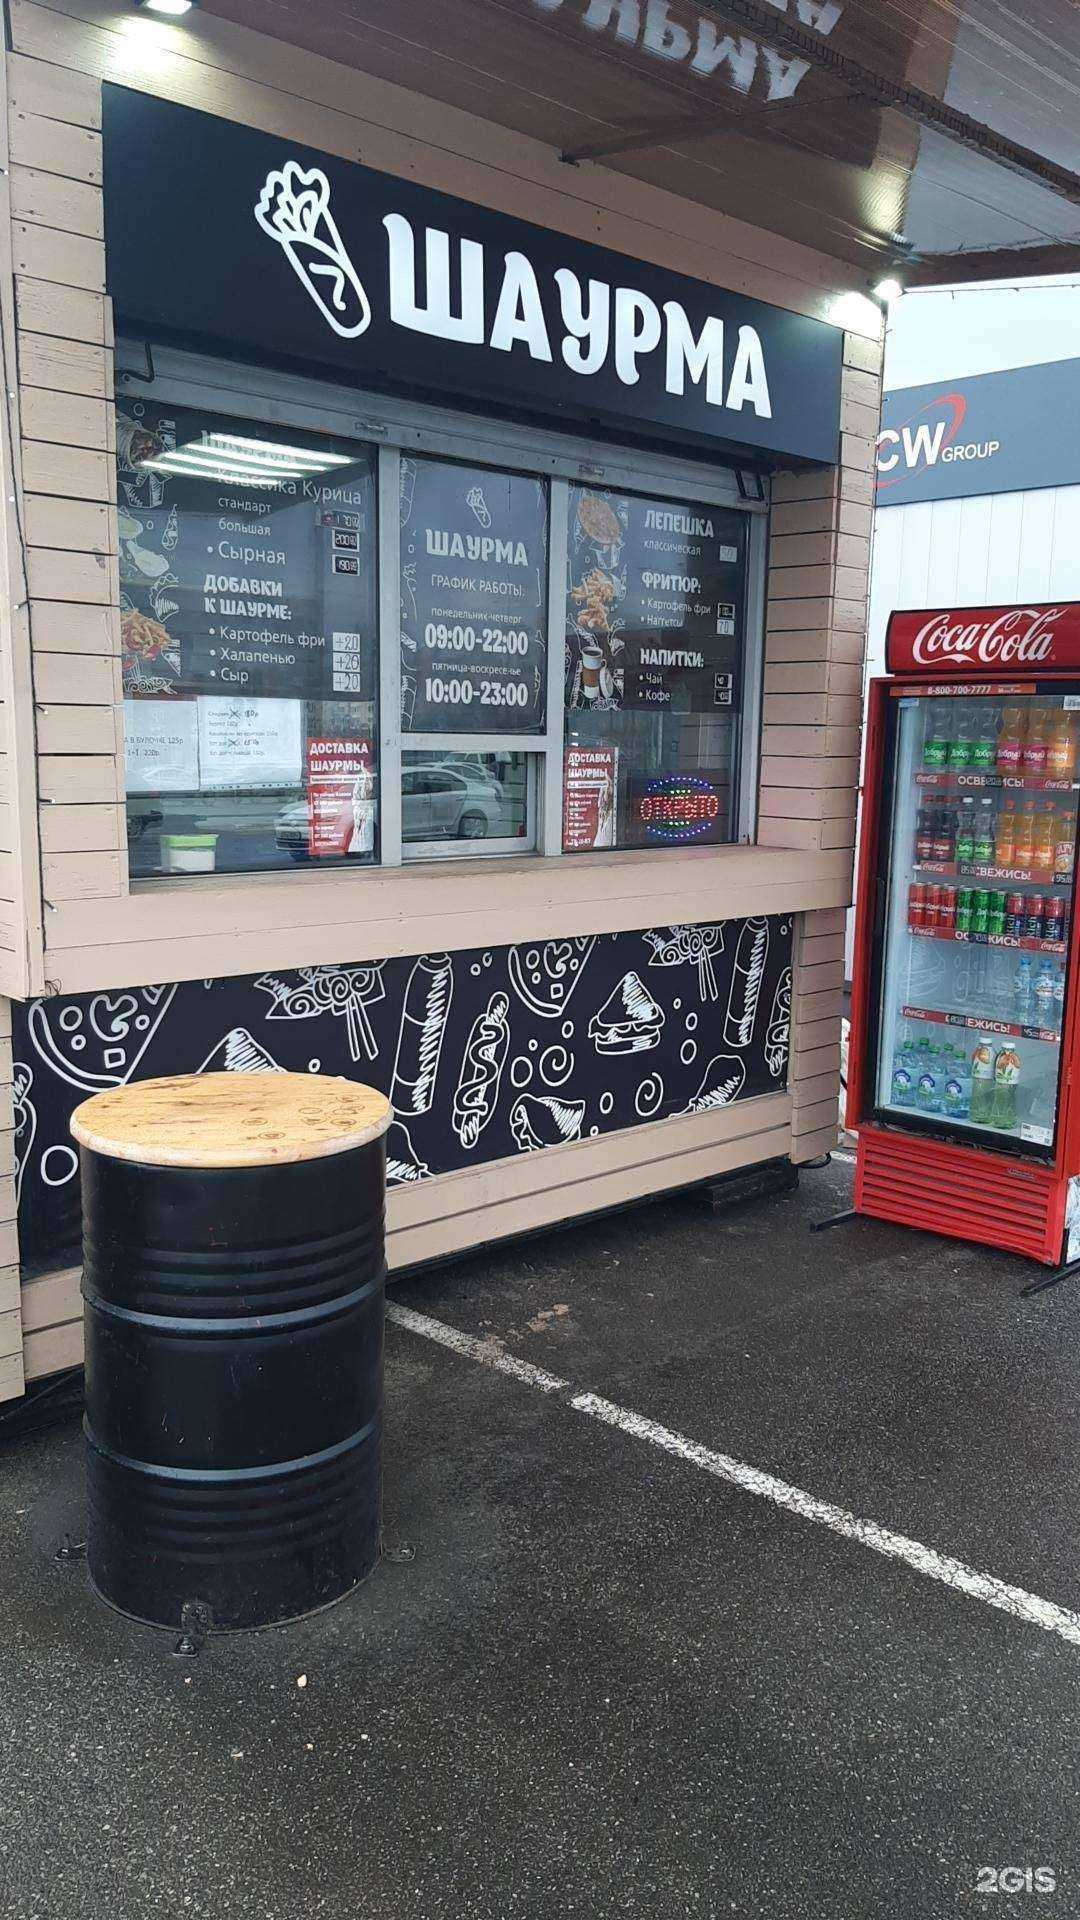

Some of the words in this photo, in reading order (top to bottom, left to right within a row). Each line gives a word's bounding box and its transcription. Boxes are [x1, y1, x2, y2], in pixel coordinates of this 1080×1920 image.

[383, 213, 772, 418] ШАУРМА
[875, 421, 946, 472] CW
[941, 440, 1000, 463] GROUP
[302, 480, 361, 505] Курица
[218, 497, 271, 514] стандарт
[218, 517, 271, 536] большая
[644, 510, 714, 538] ЛЕПЕШКА
[218, 540, 286, 566] Сырная
[425, 528, 528, 567] ШАУРМА
[644, 540, 702, 556] классическая
[203, 574, 283, 597] ДОБАВКИ
[431, 574, 476, 591] ГРАФИК
[641, 571, 701, 594] ФРИТЮР:
[204, 598, 216, 614] К
[219, 598, 292, 620] ШАУРМЕ:
[431, 606, 522, 624] понедельник-четверг
[647, 599, 692, 613] Картофель
[693, 603, 711, 616] фри
[220, 626, 294, 646] Картофель
[298, 630, 325, 648] фри
[424, 623, 529, 656] 09:00-22:00
[912, 608, 1070, 665] Coca-Cola
[220, 648, 296, 665] Халапенью
[640, 648, 704, 667] НАПИТКИ:
[220, 667, 249, 684] Сыр
[425, 677, 529, 707] 10:00-23:00
[645, 689, 671, 703] Кофе
[310, 742, 369, 756] ДОСТАВКА
[568, 753, 611, 764] ДОСТАВКА
[310, 760, 364, 772] ШАУРМЫ
[568, 768, 608, 778] ШАУРМЫ
